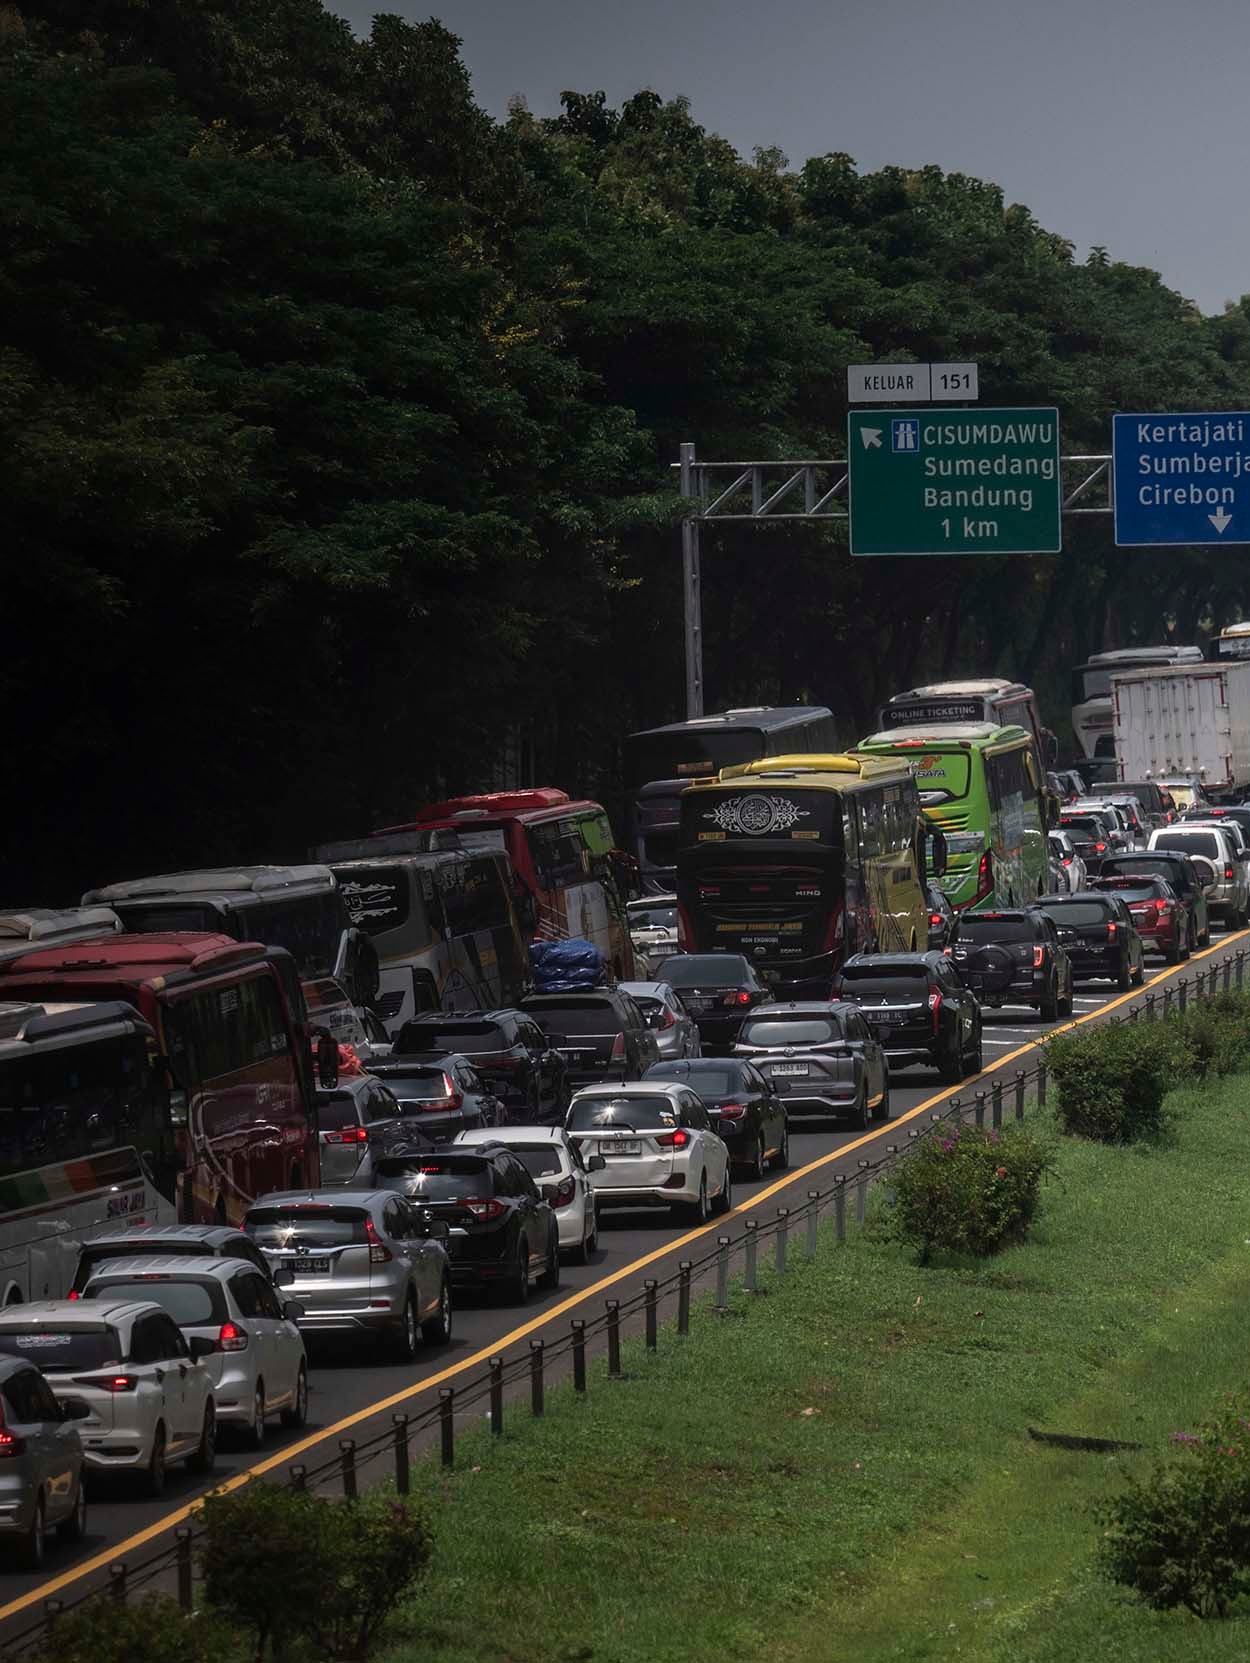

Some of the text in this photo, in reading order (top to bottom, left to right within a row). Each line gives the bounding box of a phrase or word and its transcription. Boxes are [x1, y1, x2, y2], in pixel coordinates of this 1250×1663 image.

[864, 375, 914, 391] KELUAR
[940, 373, 970, 390] 151
[923, 423, 1053, 446] CISUMDAWU
[1137, 419, 1244, 447] Kertajati
[924, 454, 1054, 480] Sumedang
[924, 485, 1033, 512] Bandung
[1139, 483, 1235, 505] Cirebon
[941, 516, 998, 538] 1 km
[890, 708, 926, 720] ONLINE
[926, 704, 976, 718] TICKETING
